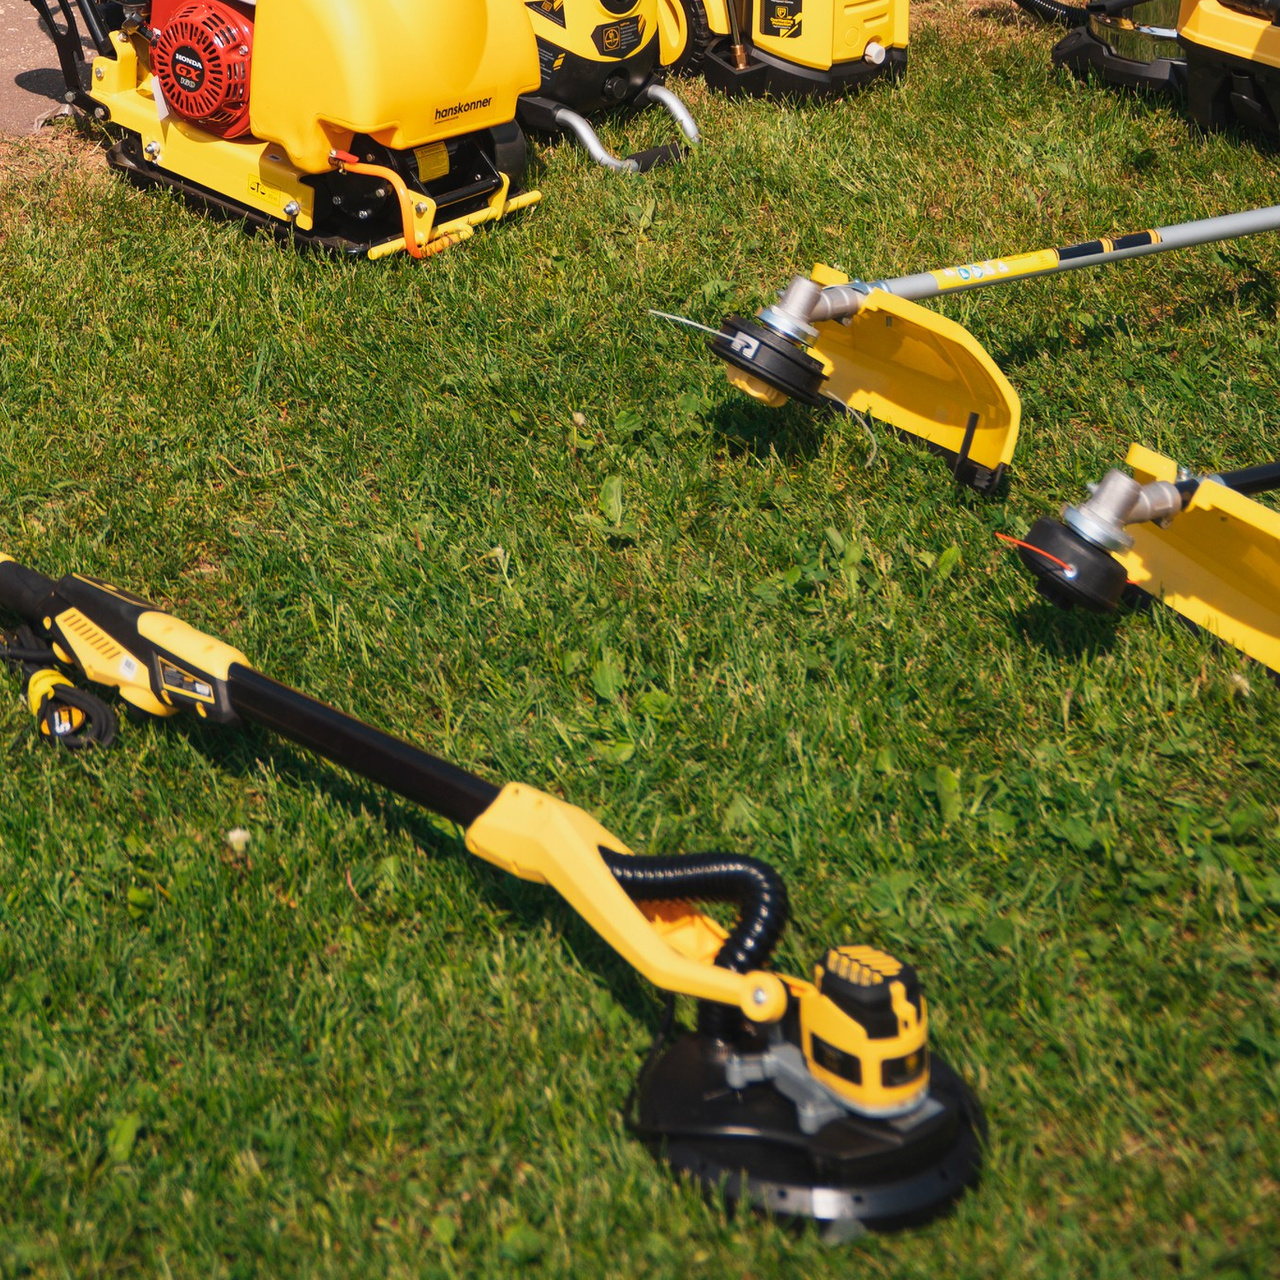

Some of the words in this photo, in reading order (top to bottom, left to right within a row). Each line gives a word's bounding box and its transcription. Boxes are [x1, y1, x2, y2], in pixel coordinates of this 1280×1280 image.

[175, 53, 203, 69] HONDA
[175, 63, 201, 81] GX
[434, 97, 492, 120] hanskonner
